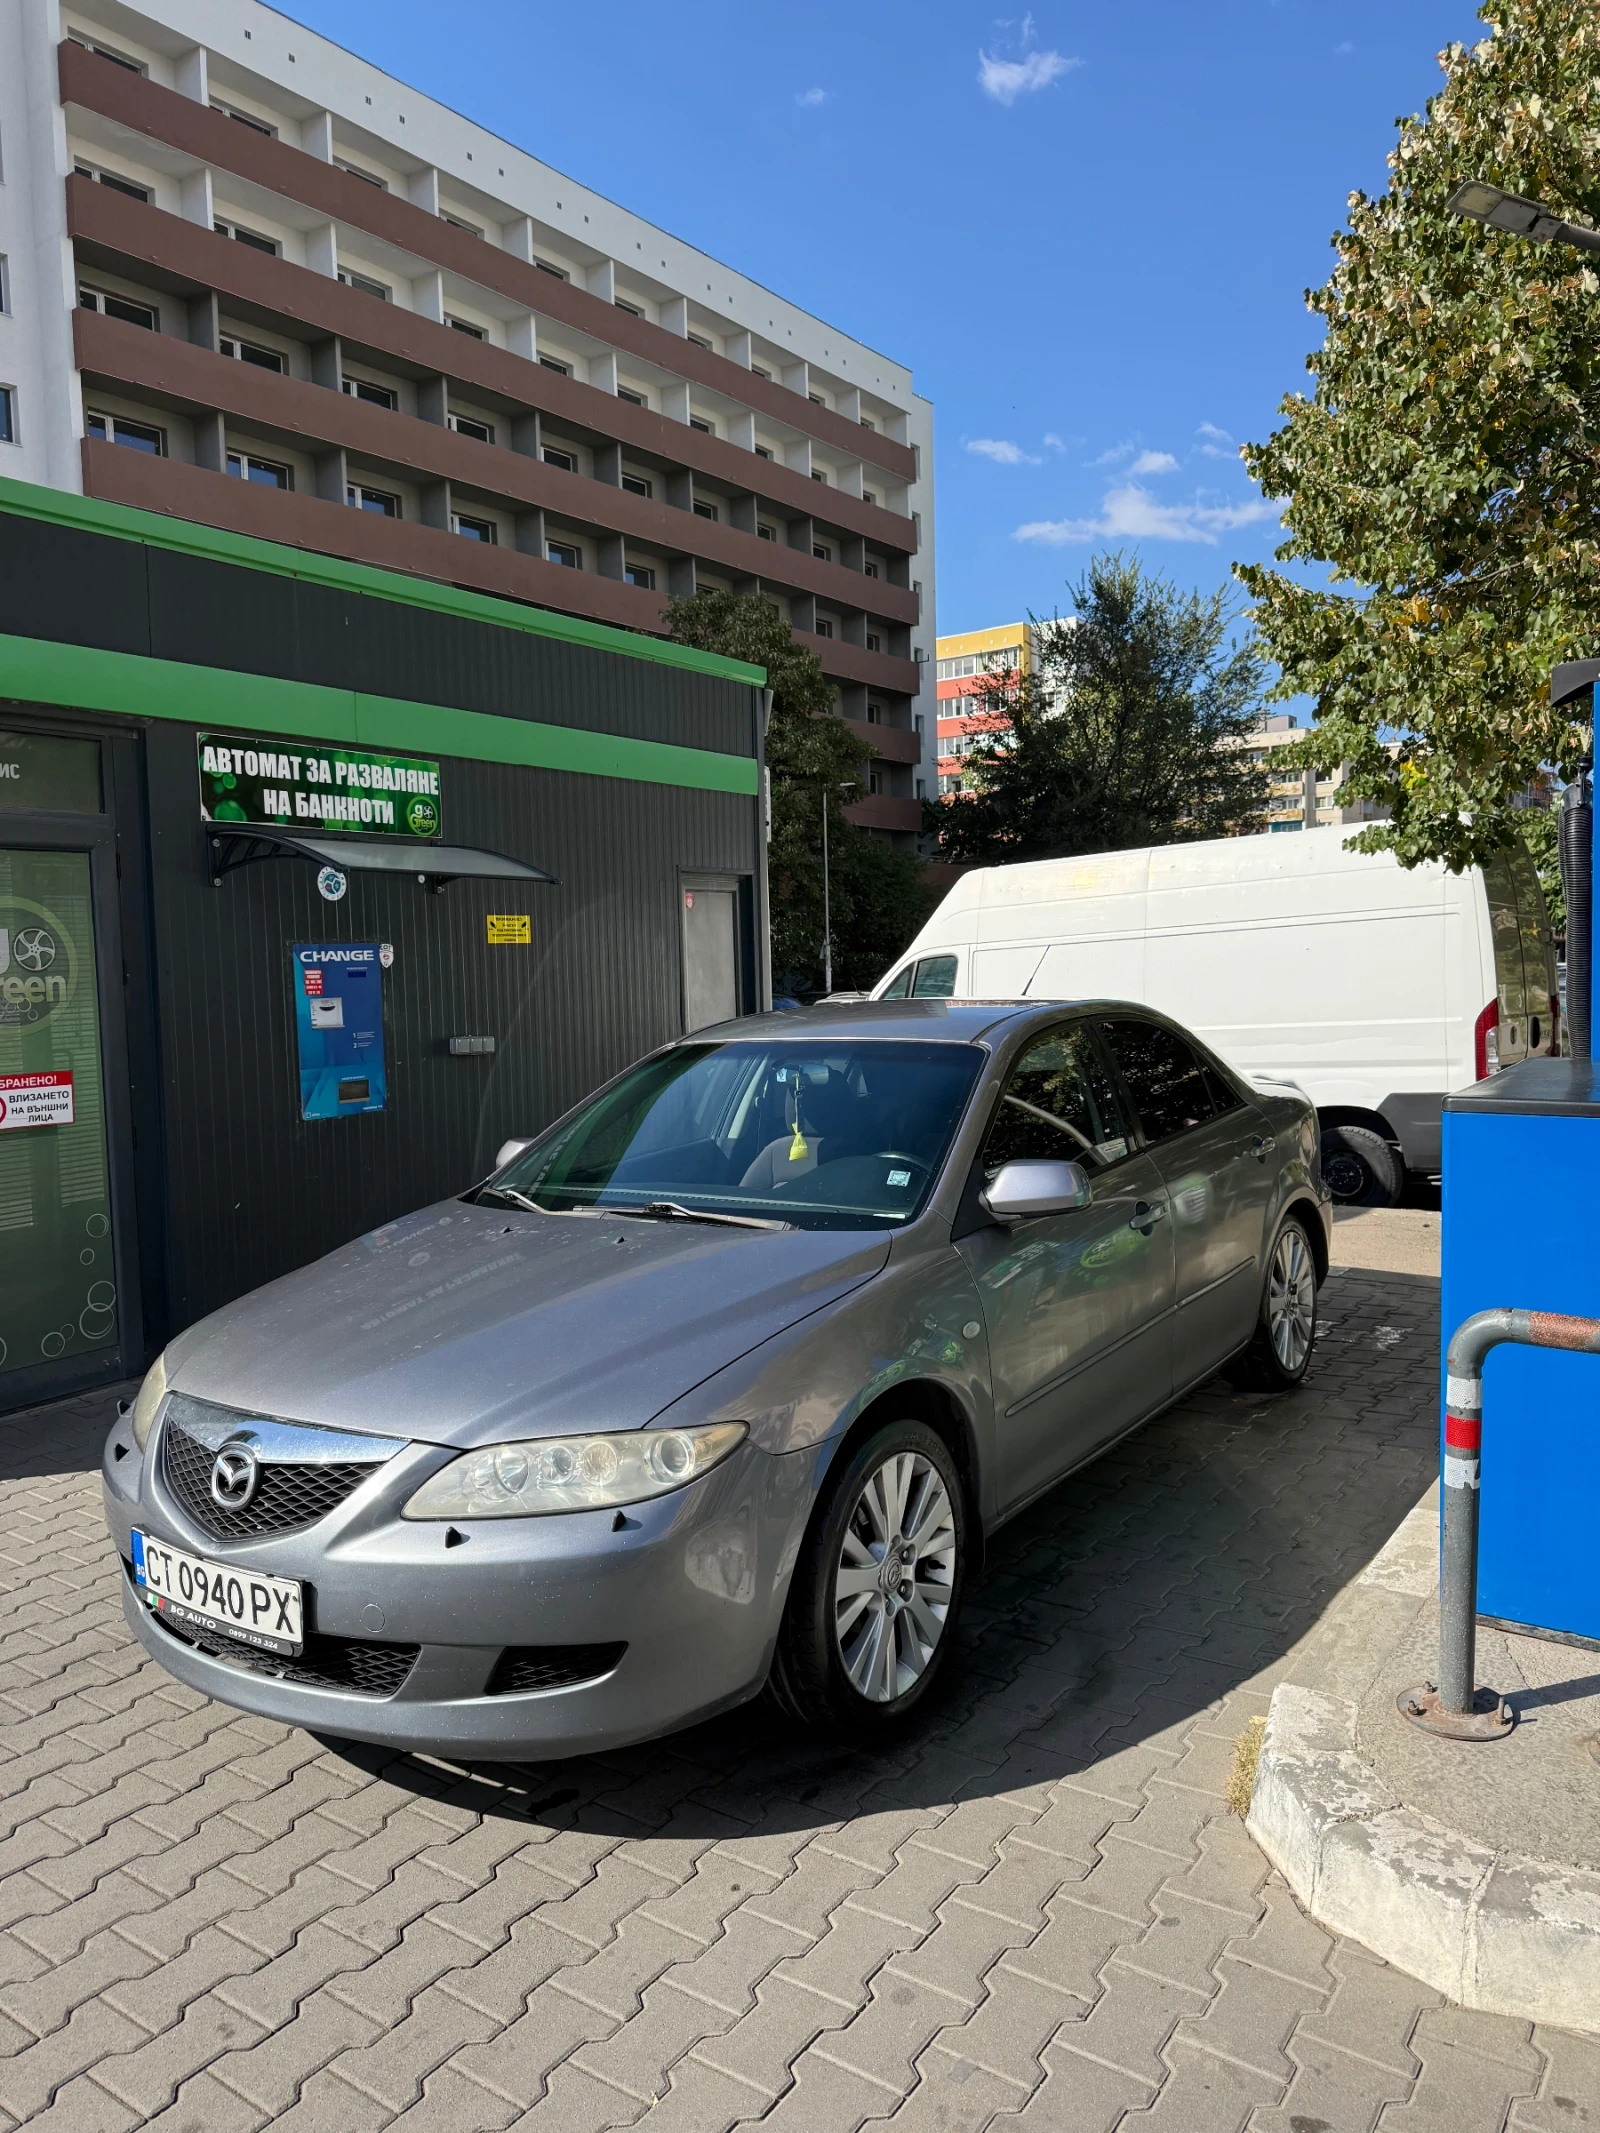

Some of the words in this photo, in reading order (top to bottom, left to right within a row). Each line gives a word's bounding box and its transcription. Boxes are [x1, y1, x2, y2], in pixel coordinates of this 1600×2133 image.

[203, 746, 302, 780] АВТОМАТ
[306, 757, 332, 784] ЗА
[335, 761, 439, 795] РАЗВАЛЯНЕ
[263, 789, 292, 816] НА
[295, 792, 394, 825] БАНКНОТИ
[410, 813, 436, 828] Green
[300, 950, 374, 962] CHANGE
[9, 1090, 69, 1103] ВЛИЗАНЕТО
[27, 1103, 69, 1113] ВЪНШНИ
[28, 1113, 54, 1122] ЛИЦА
[136, 1563, 146, 1577] BG
[146, 1545, 172, 1593] CT
[179, 1560, 244, 1620] 0940
[250, 1582, 295, 1634] PX
[170, 1605, 185, 1617] BG
[187, 1610, 217, 1629] AUTO
[228, 1628, 247, 1640] 0899
[263, 1638, 278, 1650] 324
